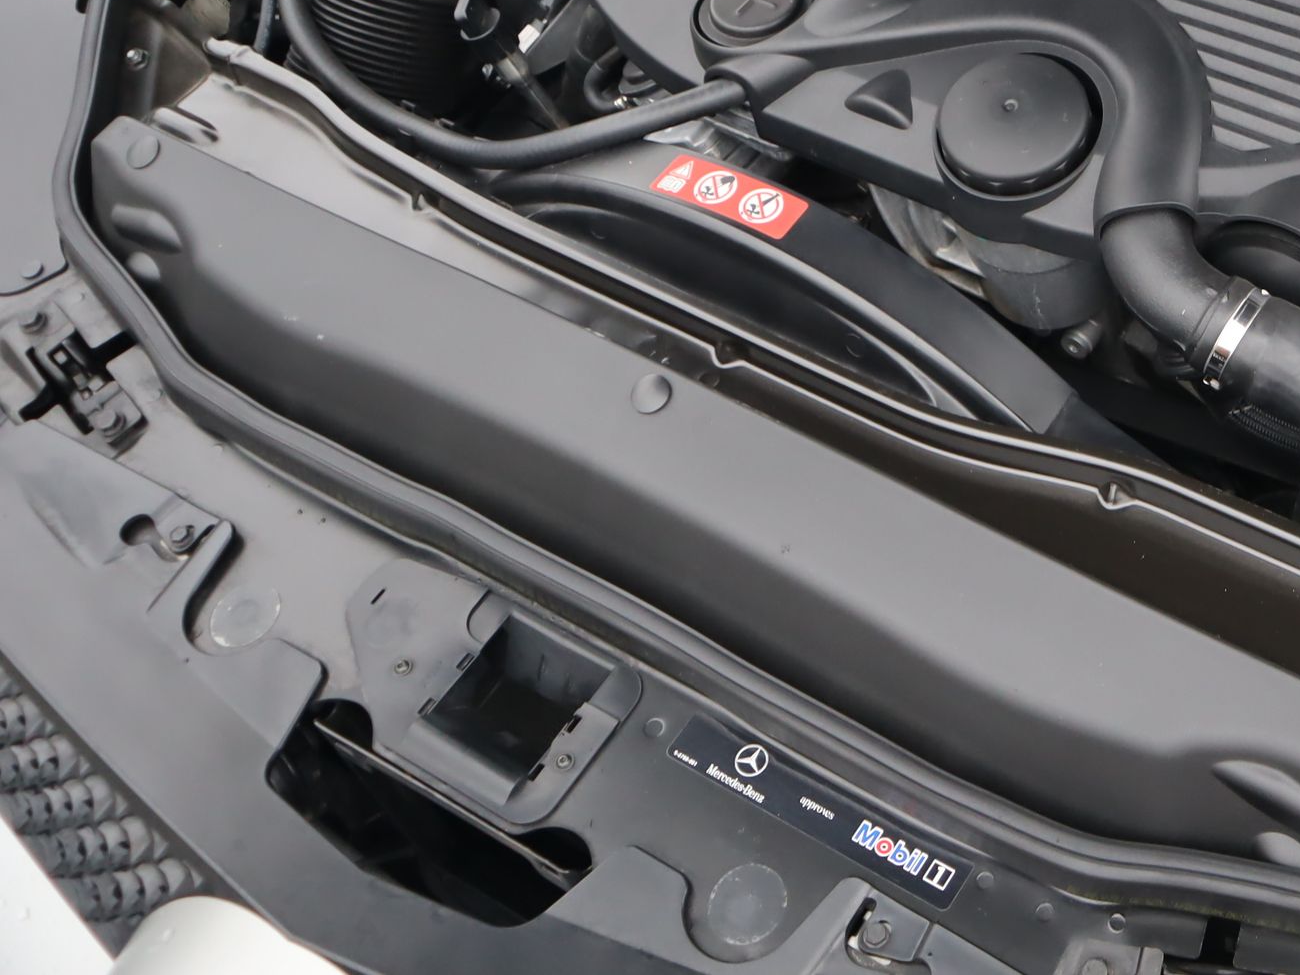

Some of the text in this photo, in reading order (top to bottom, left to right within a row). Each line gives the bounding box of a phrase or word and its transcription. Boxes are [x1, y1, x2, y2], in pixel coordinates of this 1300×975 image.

[705, 762, 765, 804] Mercedes-Benz
[799, 795, 835, 821] approves
[851, 819, 929, 876] Mobil
